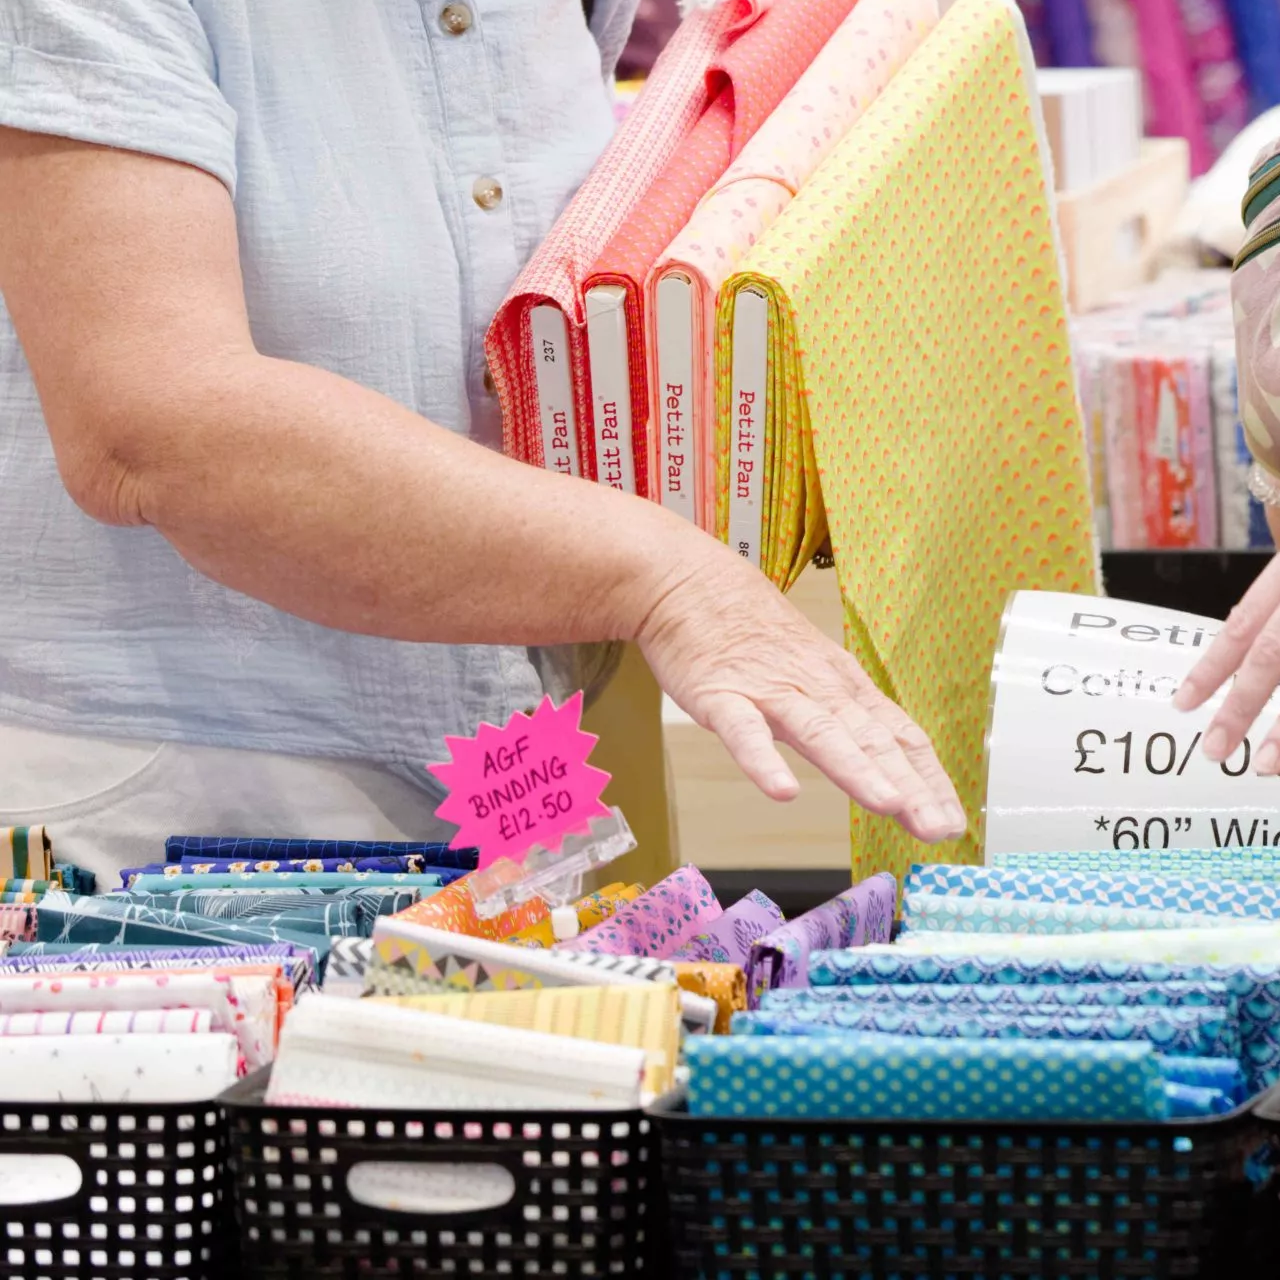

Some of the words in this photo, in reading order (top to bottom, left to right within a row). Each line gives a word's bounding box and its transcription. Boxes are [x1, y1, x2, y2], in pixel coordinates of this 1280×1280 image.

[542, 339, 555, 363] 237
[552, 411, 568, 449] Pan
[602, 401, 618, 440] Pan
[666, 383, 685, 446] Petit
[738, 390, 755, 452] Petit
[668, 452, 684, 492] Pan
[737, 459, 753, 498] Pan
[1068, 612, 1219, 647] Peti
[1041, 664, 1178, 696] Cotto
[483, 735, 530, 778] AGF
[468, 756, 568, 819] BINDING
